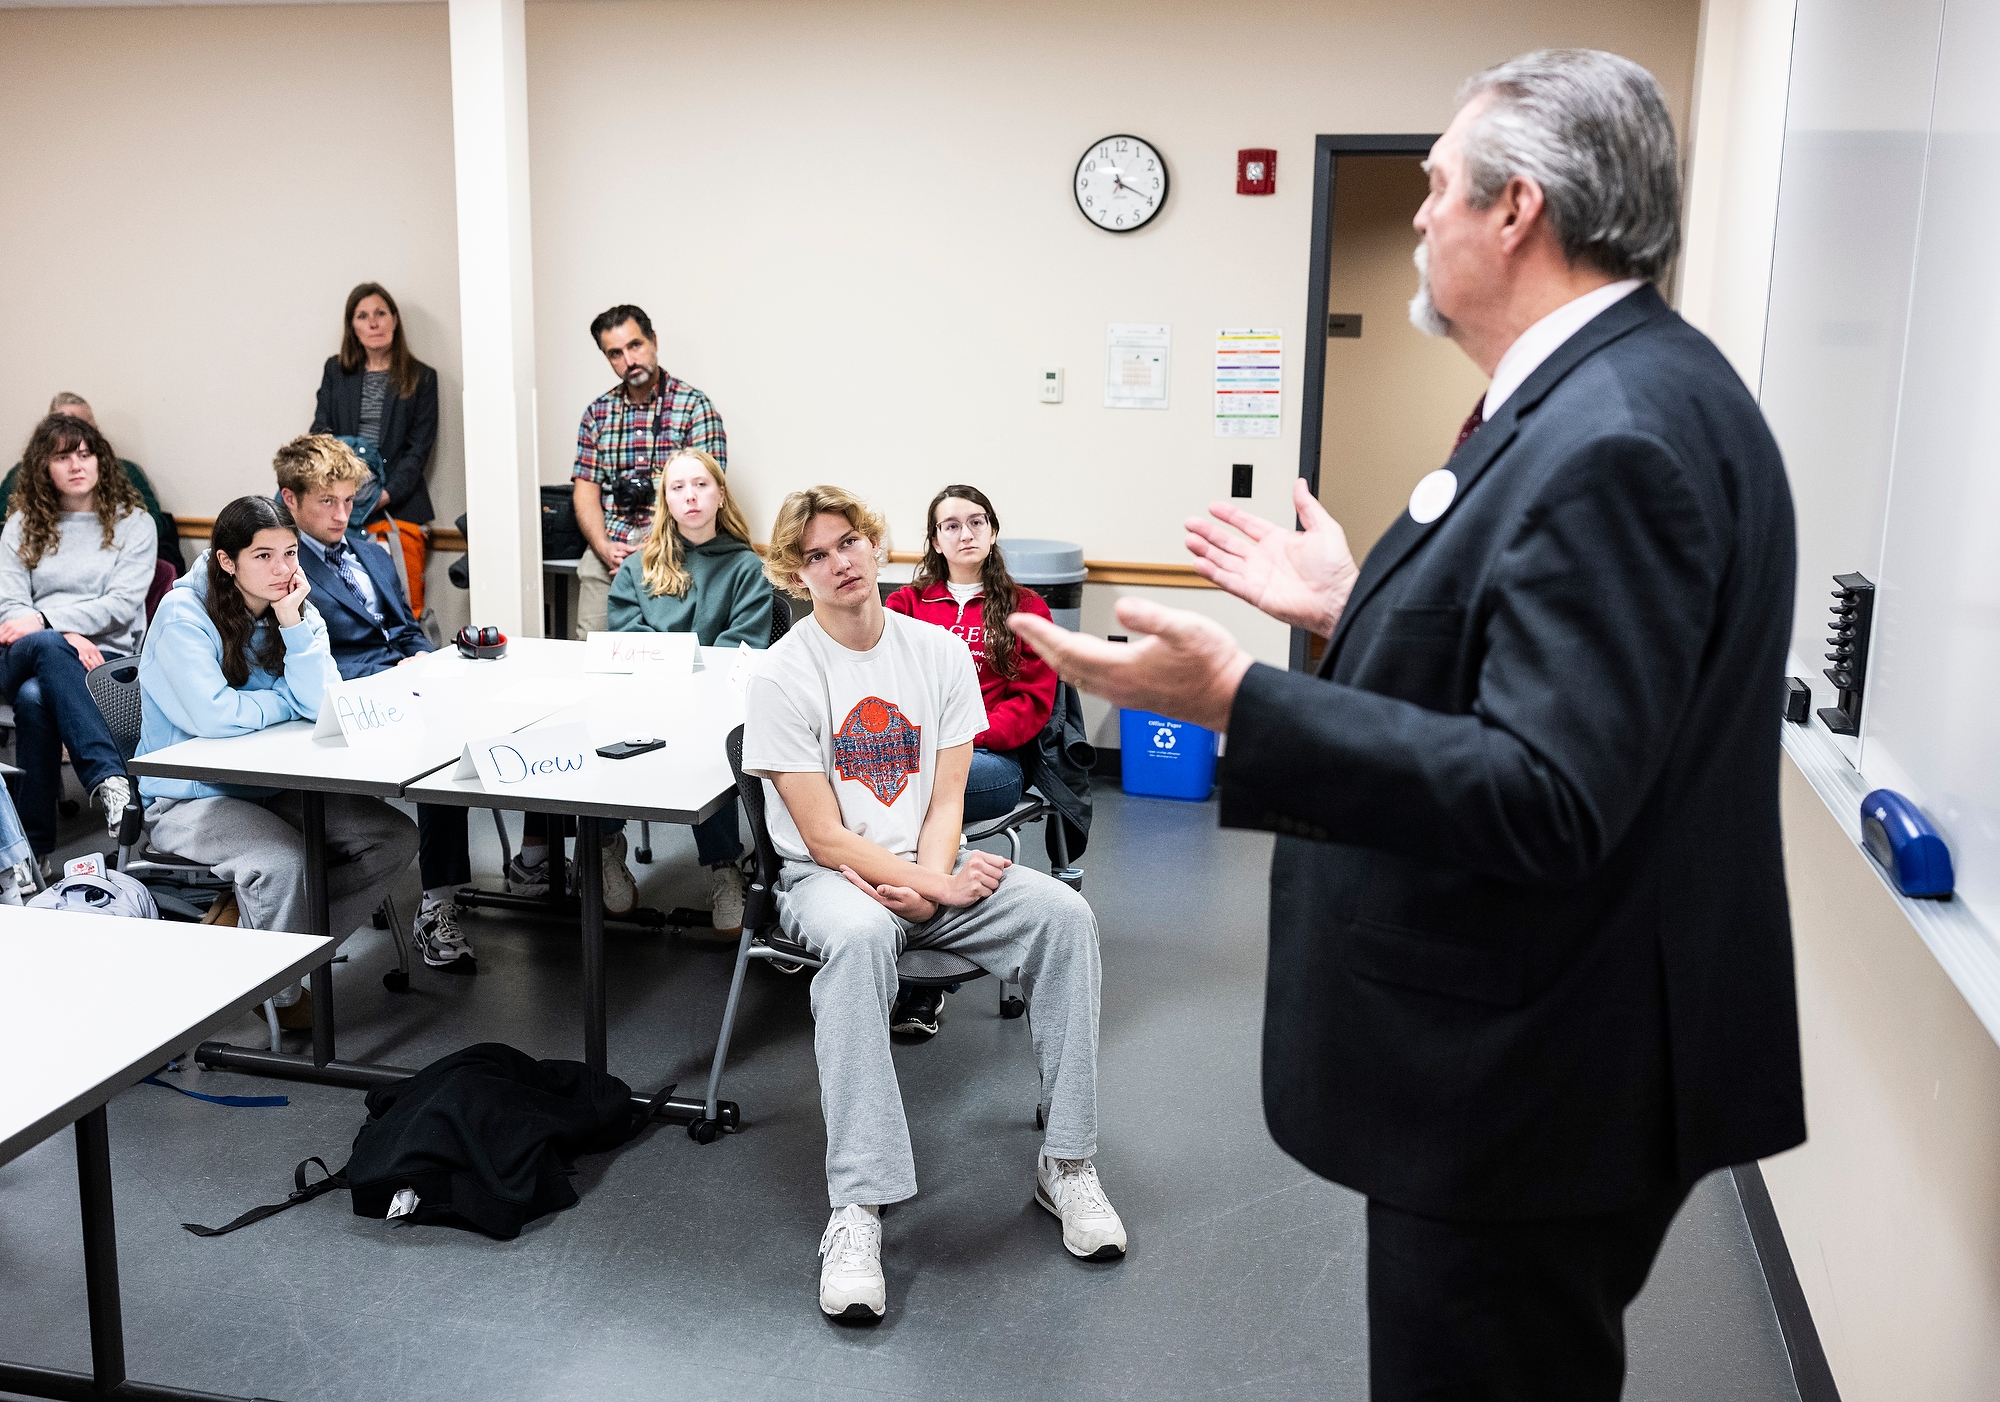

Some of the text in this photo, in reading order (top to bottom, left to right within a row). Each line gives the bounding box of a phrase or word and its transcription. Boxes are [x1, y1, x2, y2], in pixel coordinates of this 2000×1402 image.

[1115, 140, 1128, 152] 12
[1136, 146, 1140, 158] 1
[1100, 147, 1109, 158] 11
[1084, 160, 1096, 172] 10
[1147, 159, 1155, 171] 2
[1080, 179, 1088, 190] 9
[1152, 177, 1160, 189] 3
[1085, 196, 1093, 207] 8
[1146, 195, 1154, 207] 4
[1099, 210, 1107, 221] 7
[1115, 215, 1123, 226] 6
[1132, 210, 1140, 221] 5
[611, 639, 665, 662] Kate
[337, 696, 404, 735] Addie
[489, 744, 583, 783] Drew
